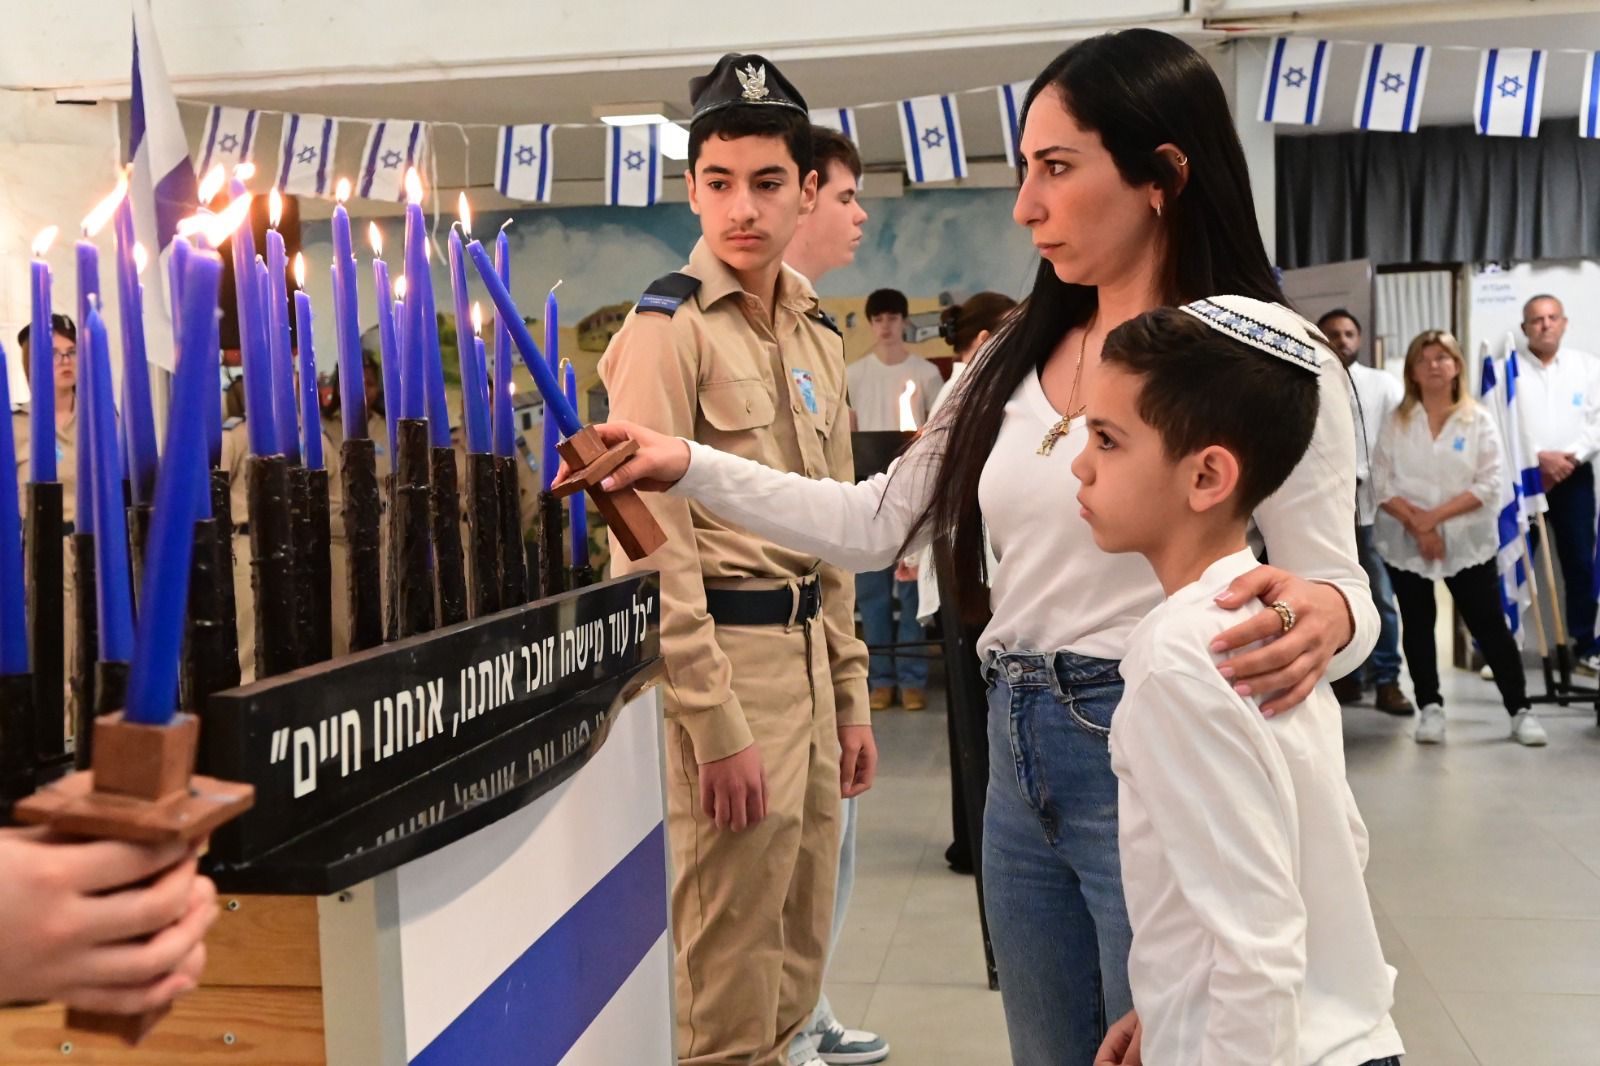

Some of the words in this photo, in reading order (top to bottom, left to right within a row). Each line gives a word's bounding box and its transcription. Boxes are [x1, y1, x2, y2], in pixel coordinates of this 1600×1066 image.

[560, 617, 604, 678] מישהו
[608, 608, 629, 659] עוד
[452, 650, 515, 738] אותנו,
[521, 635, 555, 694] זוכר
[373, 676, 444, 763] אנחנו
